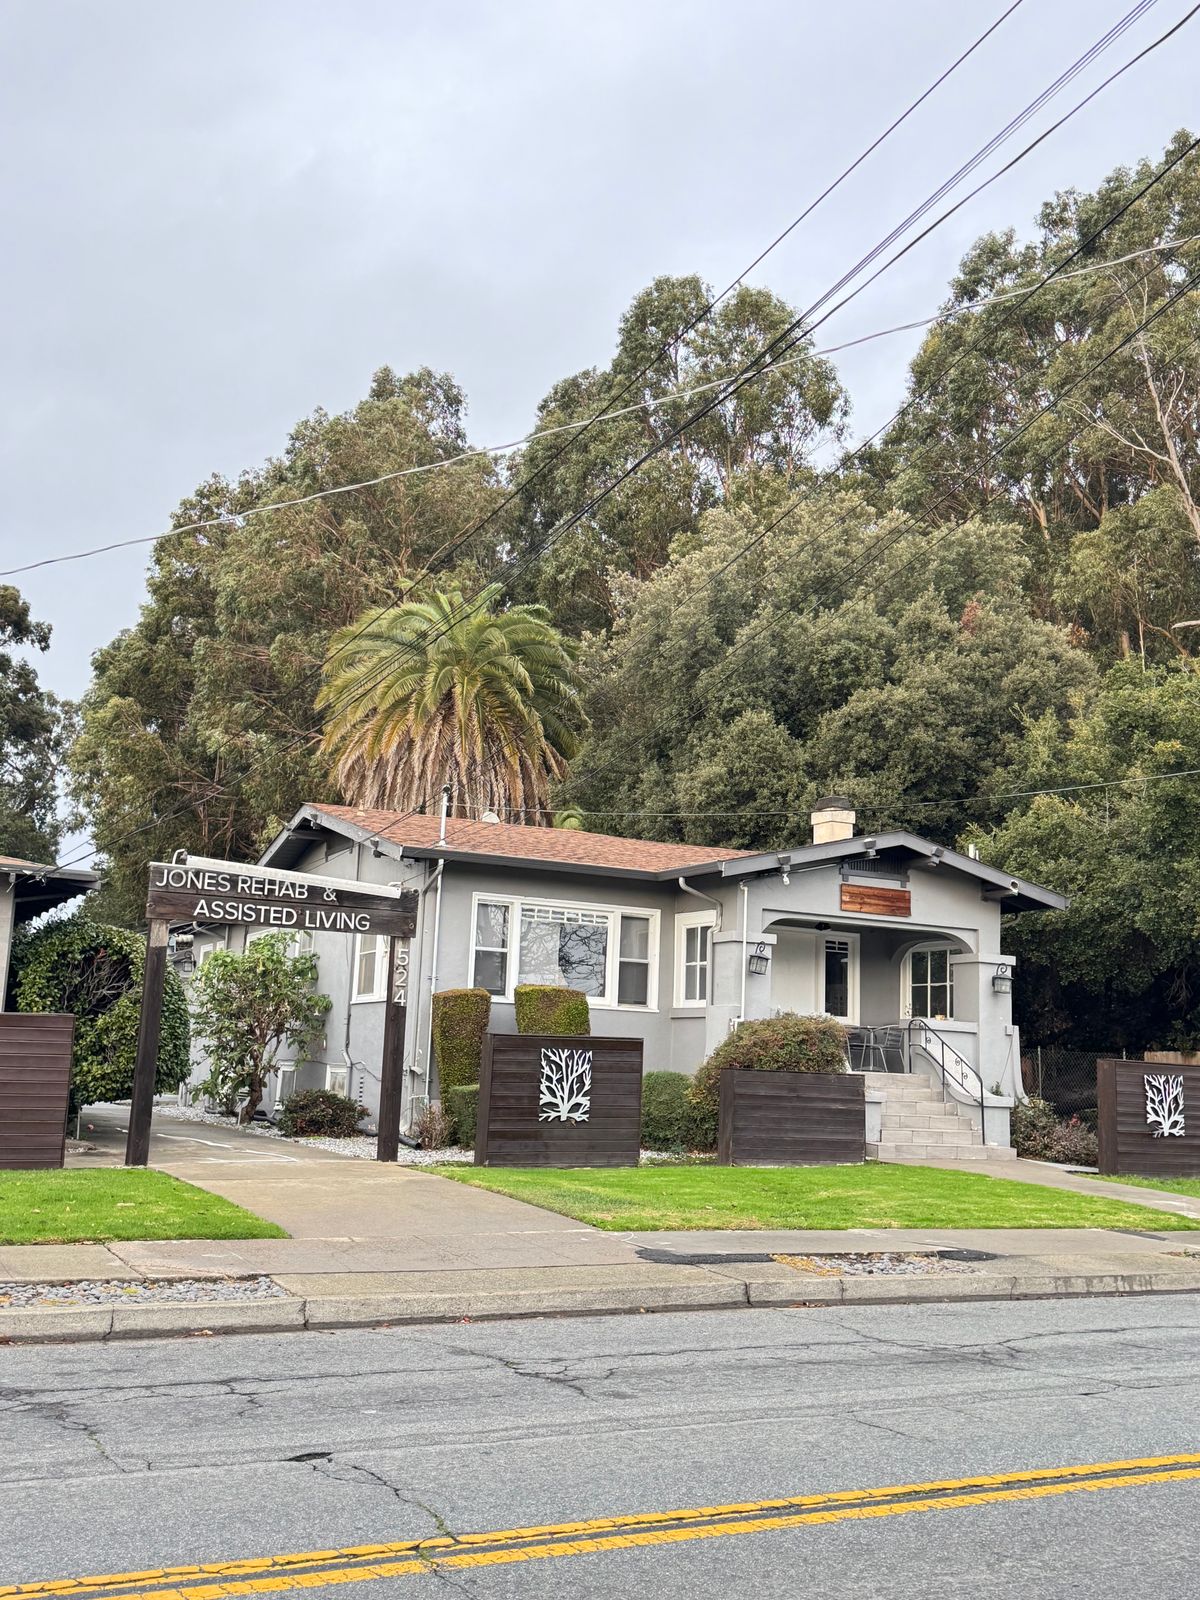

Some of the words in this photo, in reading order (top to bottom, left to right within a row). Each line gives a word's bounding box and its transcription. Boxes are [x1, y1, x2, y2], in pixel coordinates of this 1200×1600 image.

[155, 869, 231, 892] JONES
[237, 876, 308, 899] REHAB
[323, 887, 337, 901] &
[193, 899, 298, 925] ASSISTED
[305, 910, 370, 931] LIVING
[393, 948, 409, 1007] 524
